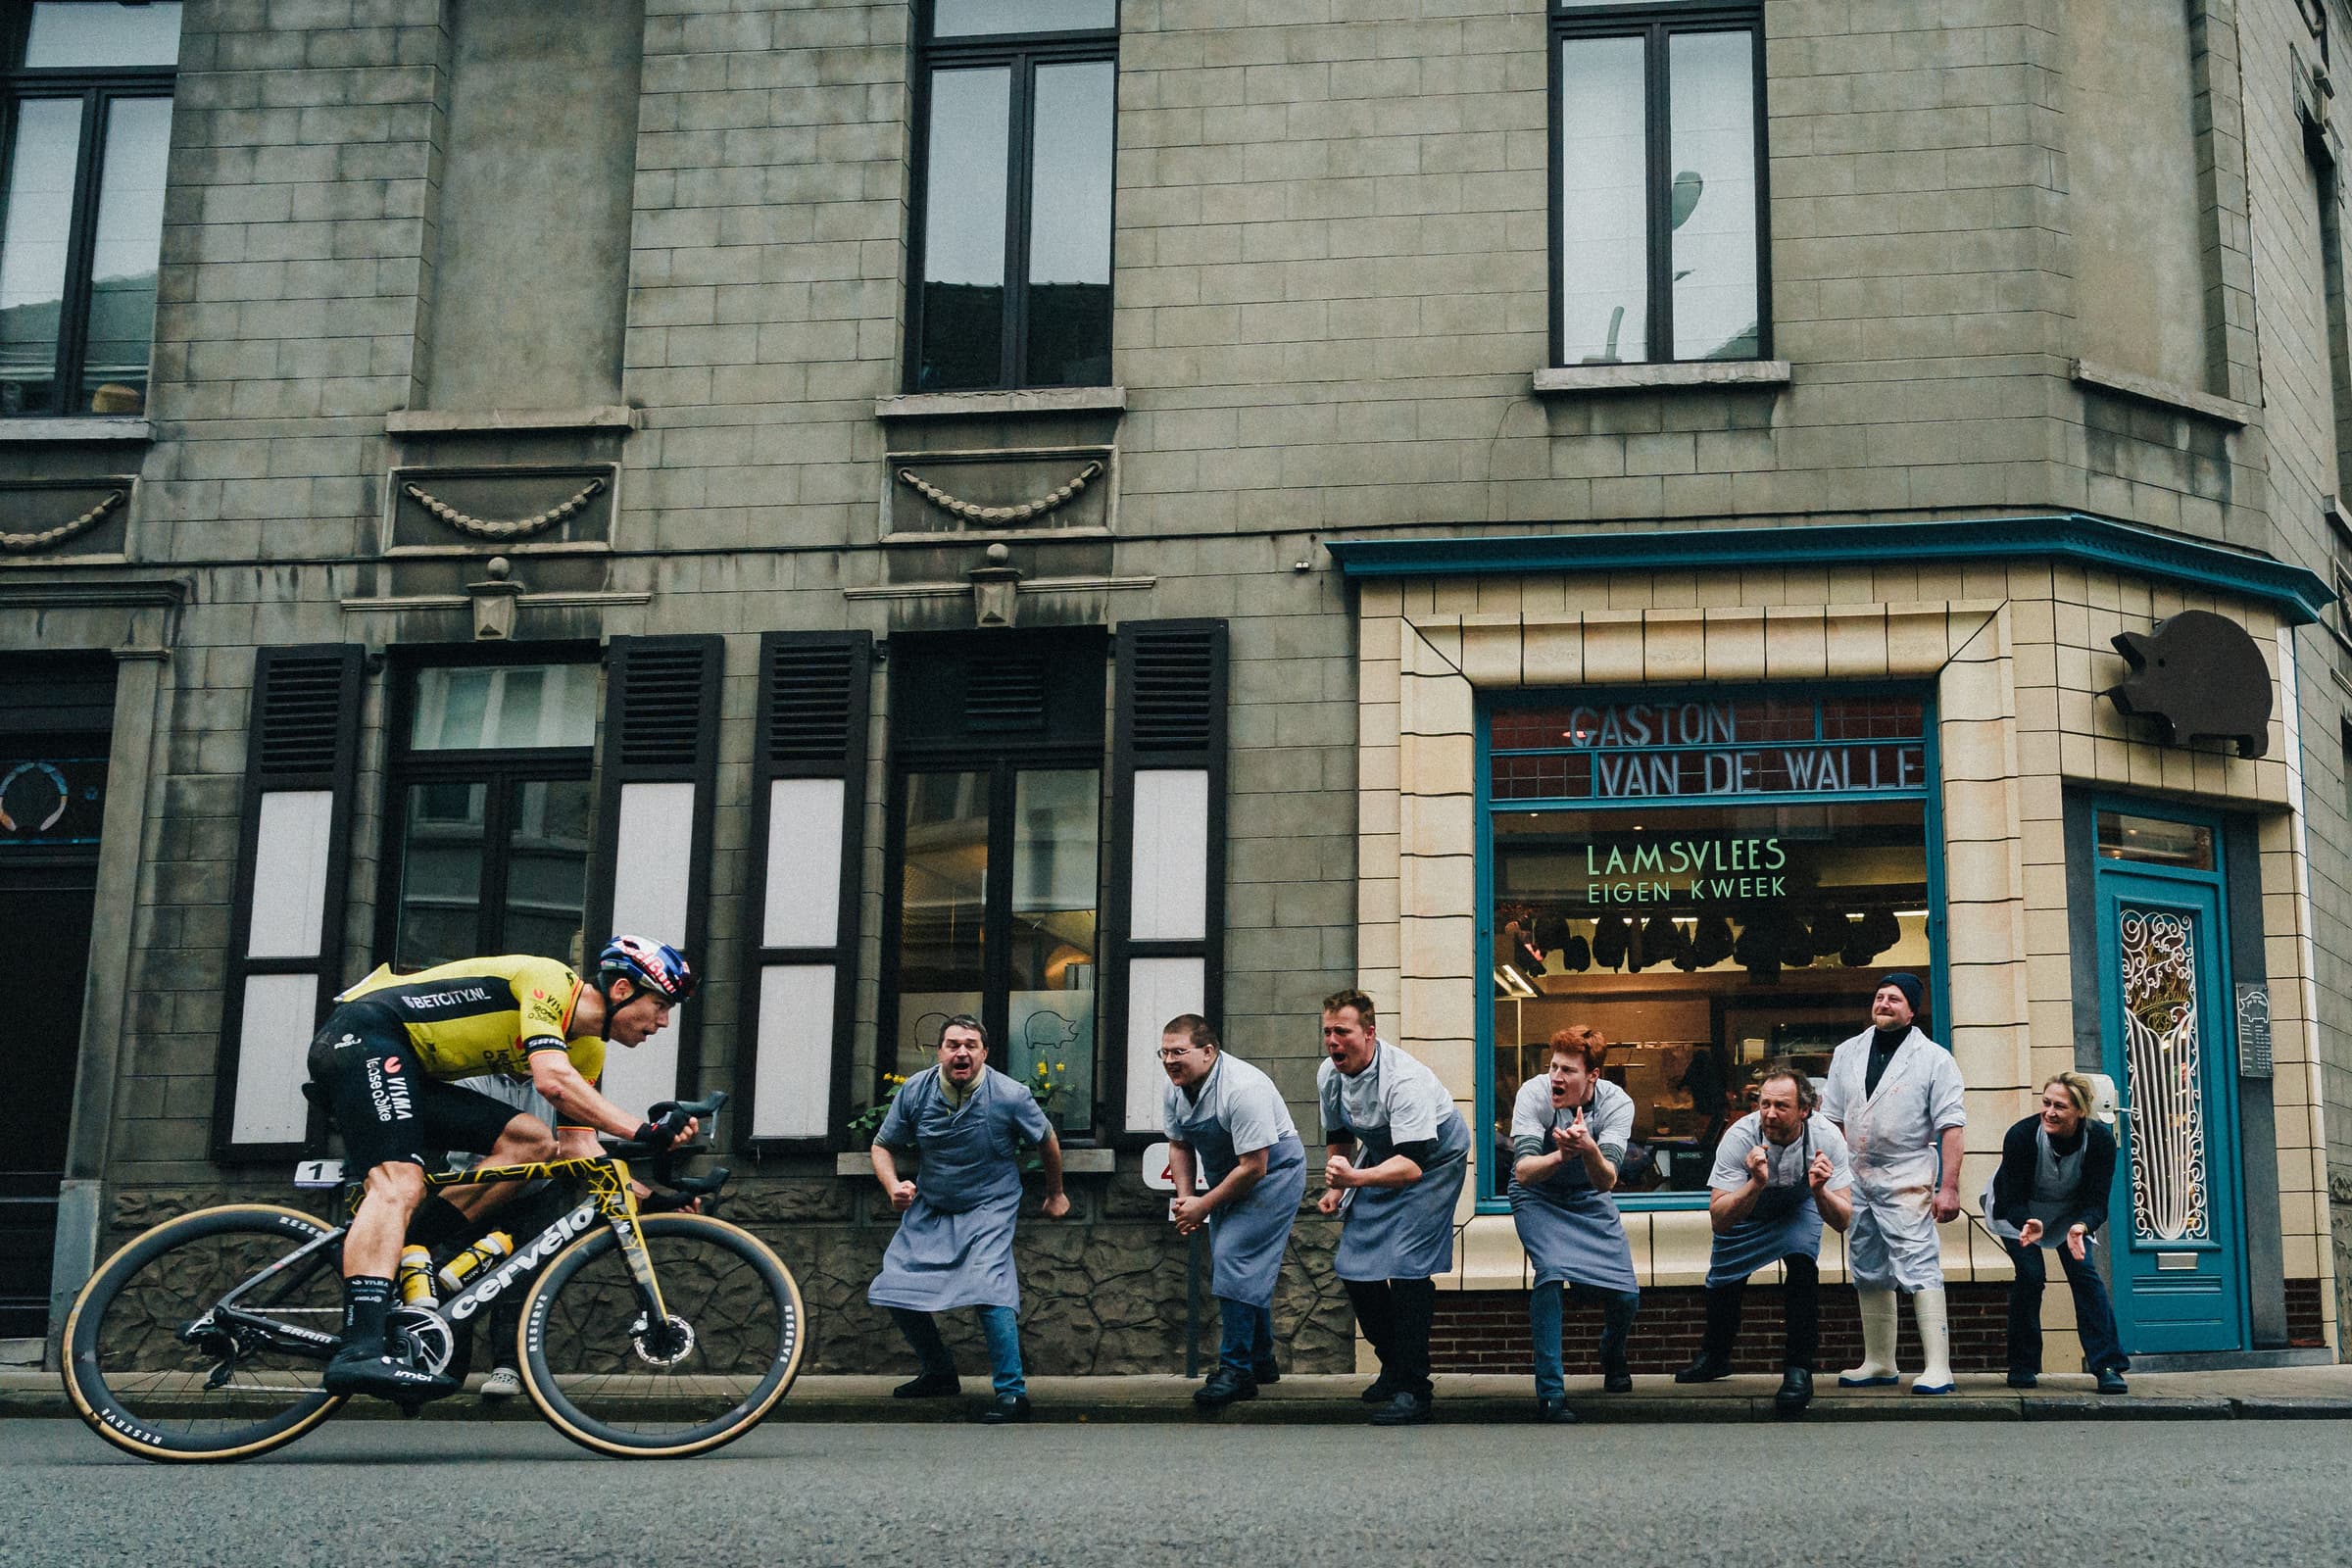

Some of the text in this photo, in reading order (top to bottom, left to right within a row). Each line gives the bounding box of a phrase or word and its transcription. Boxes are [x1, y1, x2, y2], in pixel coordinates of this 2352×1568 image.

[1570, 703, 1737, 748] GASTON
[1598, 746, 1923, 797] VAN DE WALLE
[1587, 838, 1787, 876] LAMSVLEES
[1588, 876, 1787, 905] EIGEN KWEEK
[411, 987, 493, 1009] BETCITY.NL
[386, 1077, 414, 1120] VISMA
[308, 1162, 323, 1180] 1
[452, 1206, 595, 1320] cervélo
[278, 1324, 332, 1344] SRAM
[528, 1294, 549, 1352] RESERVE
[101, 1407, 163, 1445] RESERVE
